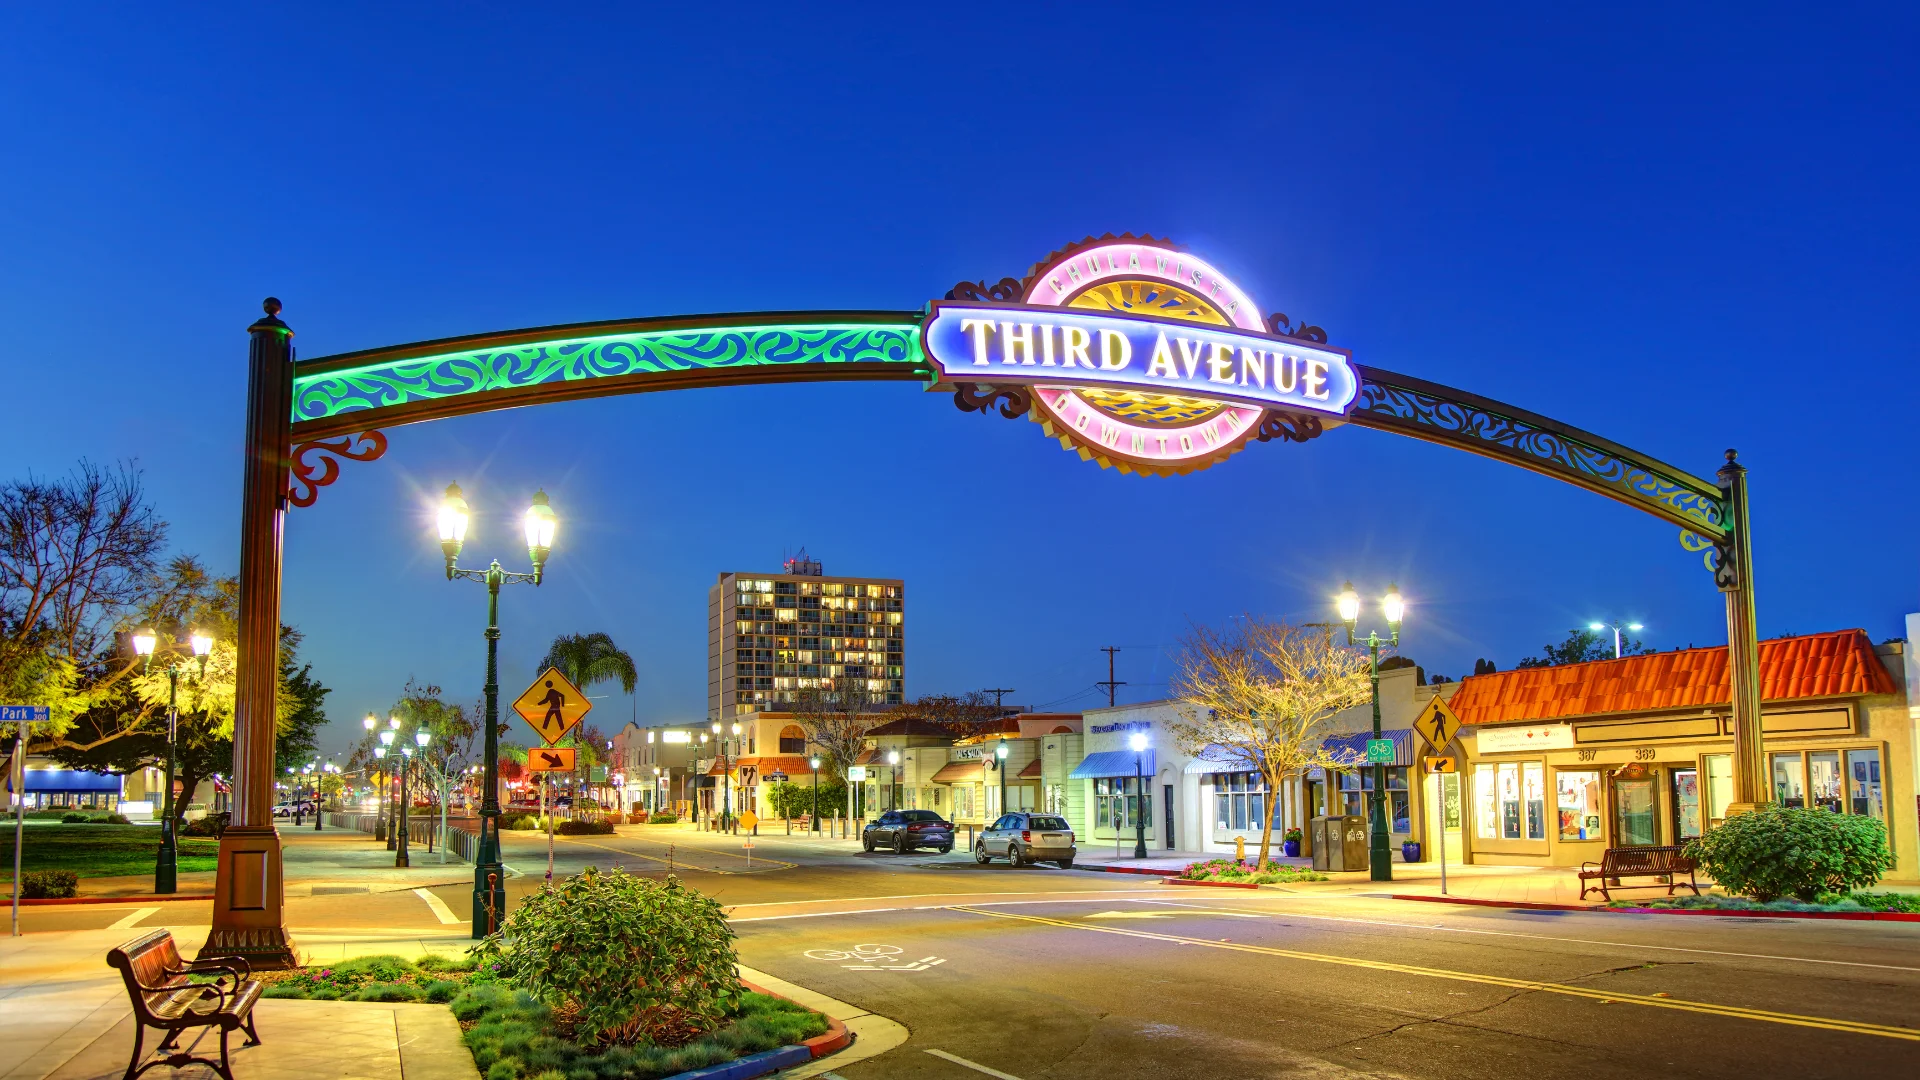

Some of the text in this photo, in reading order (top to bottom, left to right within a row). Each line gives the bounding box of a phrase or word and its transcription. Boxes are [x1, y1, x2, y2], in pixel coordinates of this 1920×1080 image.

[1048, 252, 1241, 318] CHULA VISTA
[960, 318, 1331, 401] THIRD AVENUE
[1052, 394, 1244, 455] DOWNTOWN
[2, 707, 27, 720] Park
[1578, 750, 1597, 761] 367
[1635, 749, 1656, 760] 369
